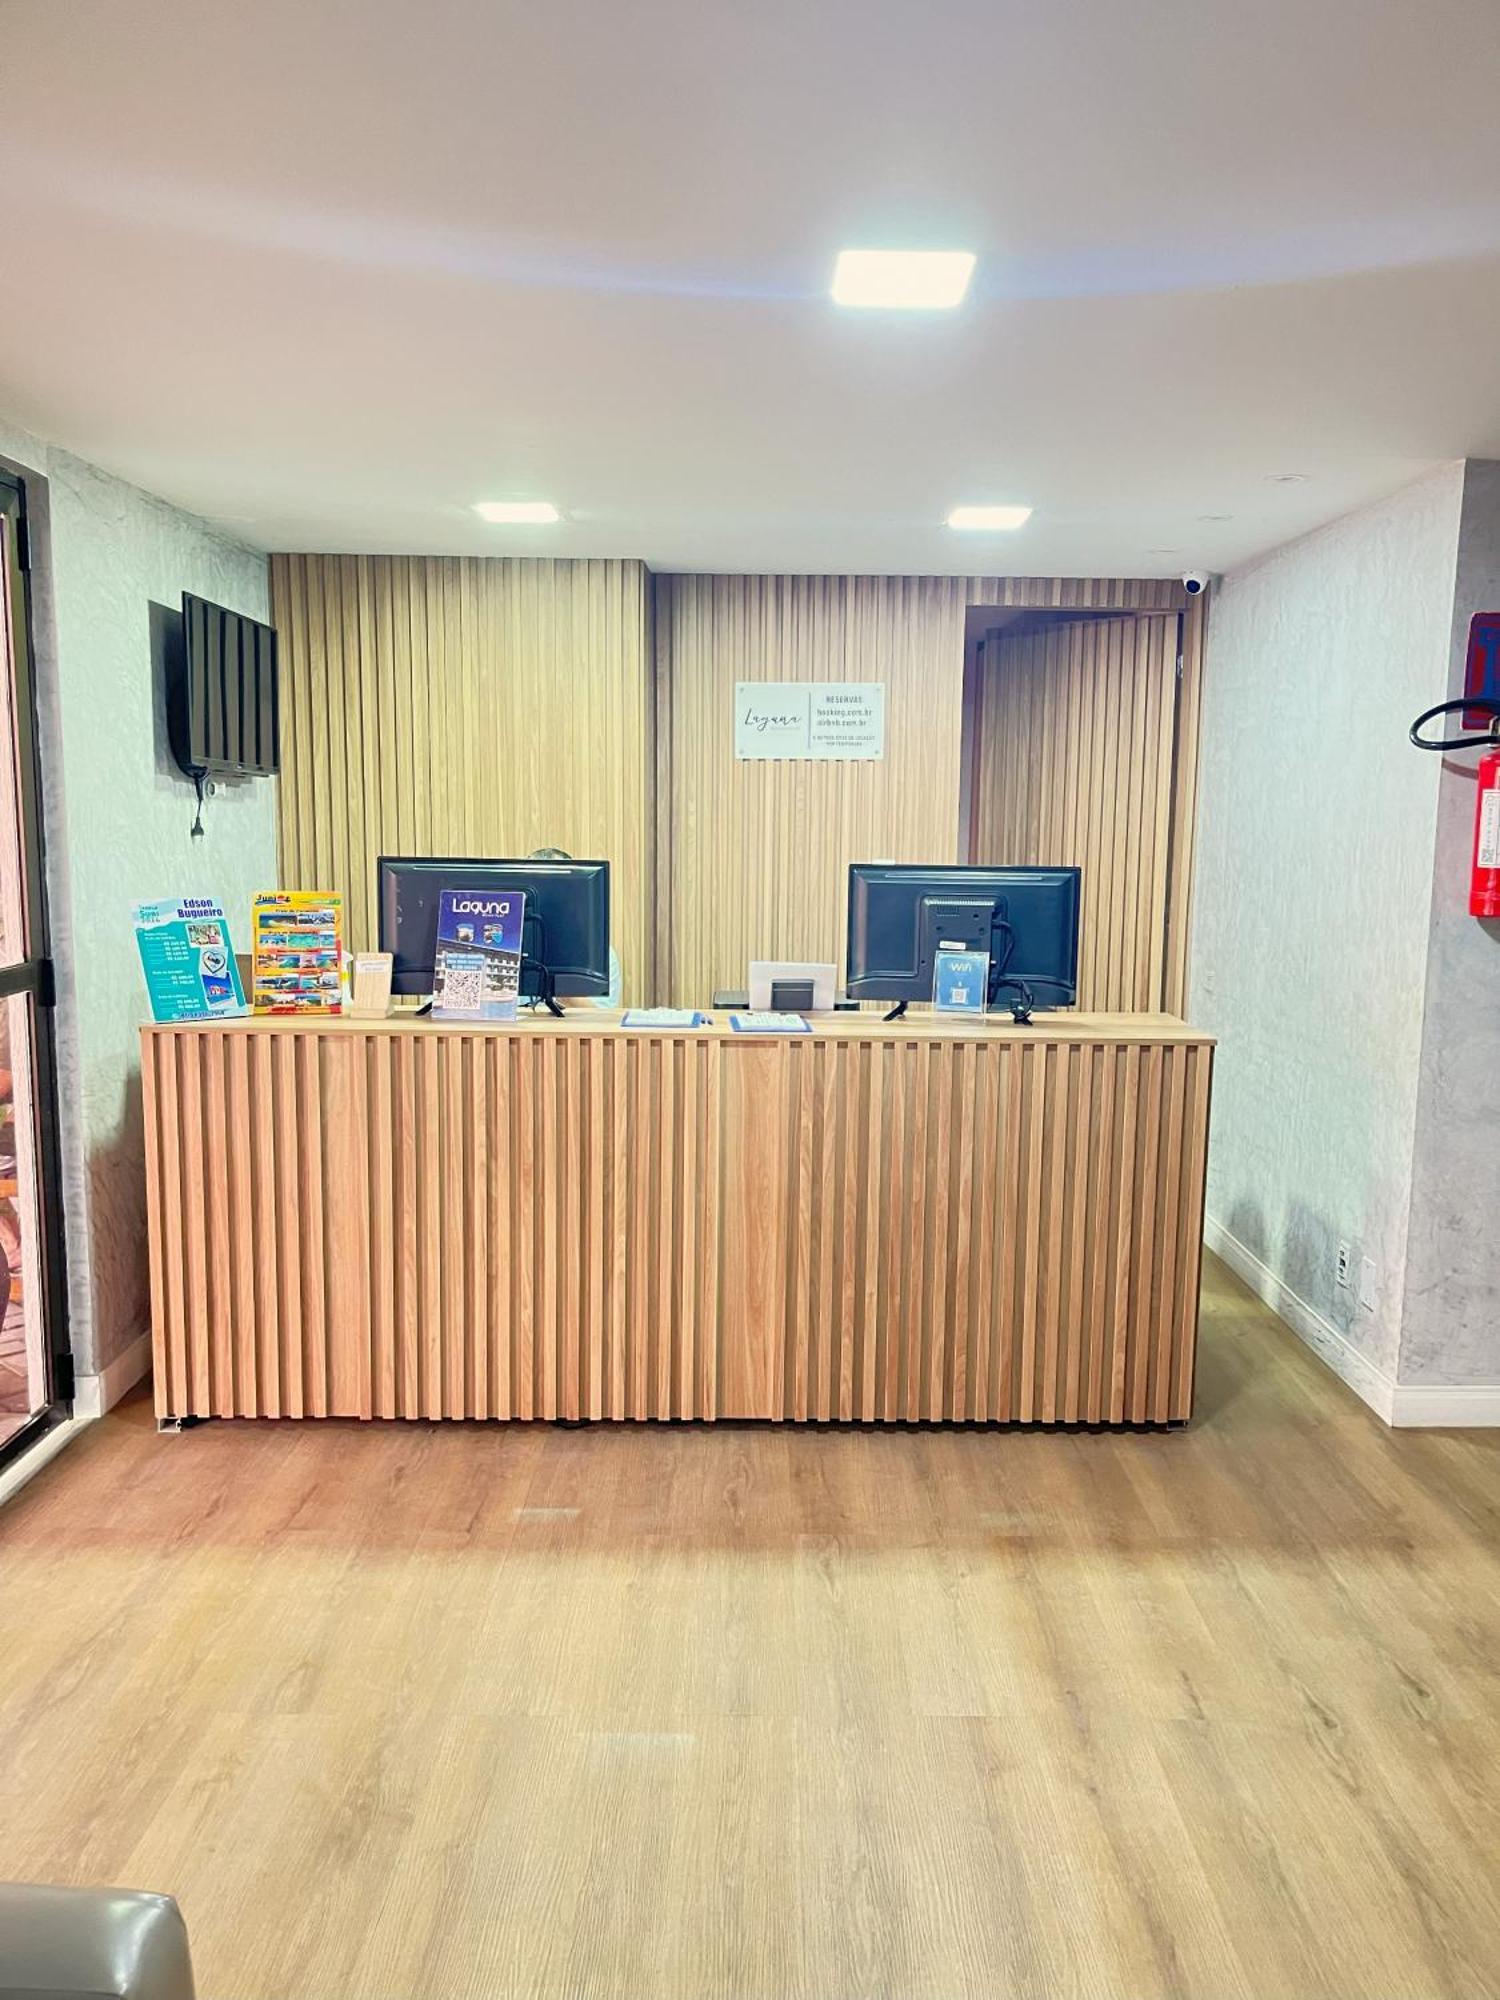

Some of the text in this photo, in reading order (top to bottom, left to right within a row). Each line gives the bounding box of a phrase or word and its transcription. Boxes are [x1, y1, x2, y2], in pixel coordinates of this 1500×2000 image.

[825, 695, 863, 704] RESERVAS
[816, 708, 873, 718] booking.com.br
[744, 708, 801, 732] Laguna
[183, 899, 213, 909] Edson
[452, 897, 510, 915] Laguna
[176, 908, 224, 919] Bugueiro
